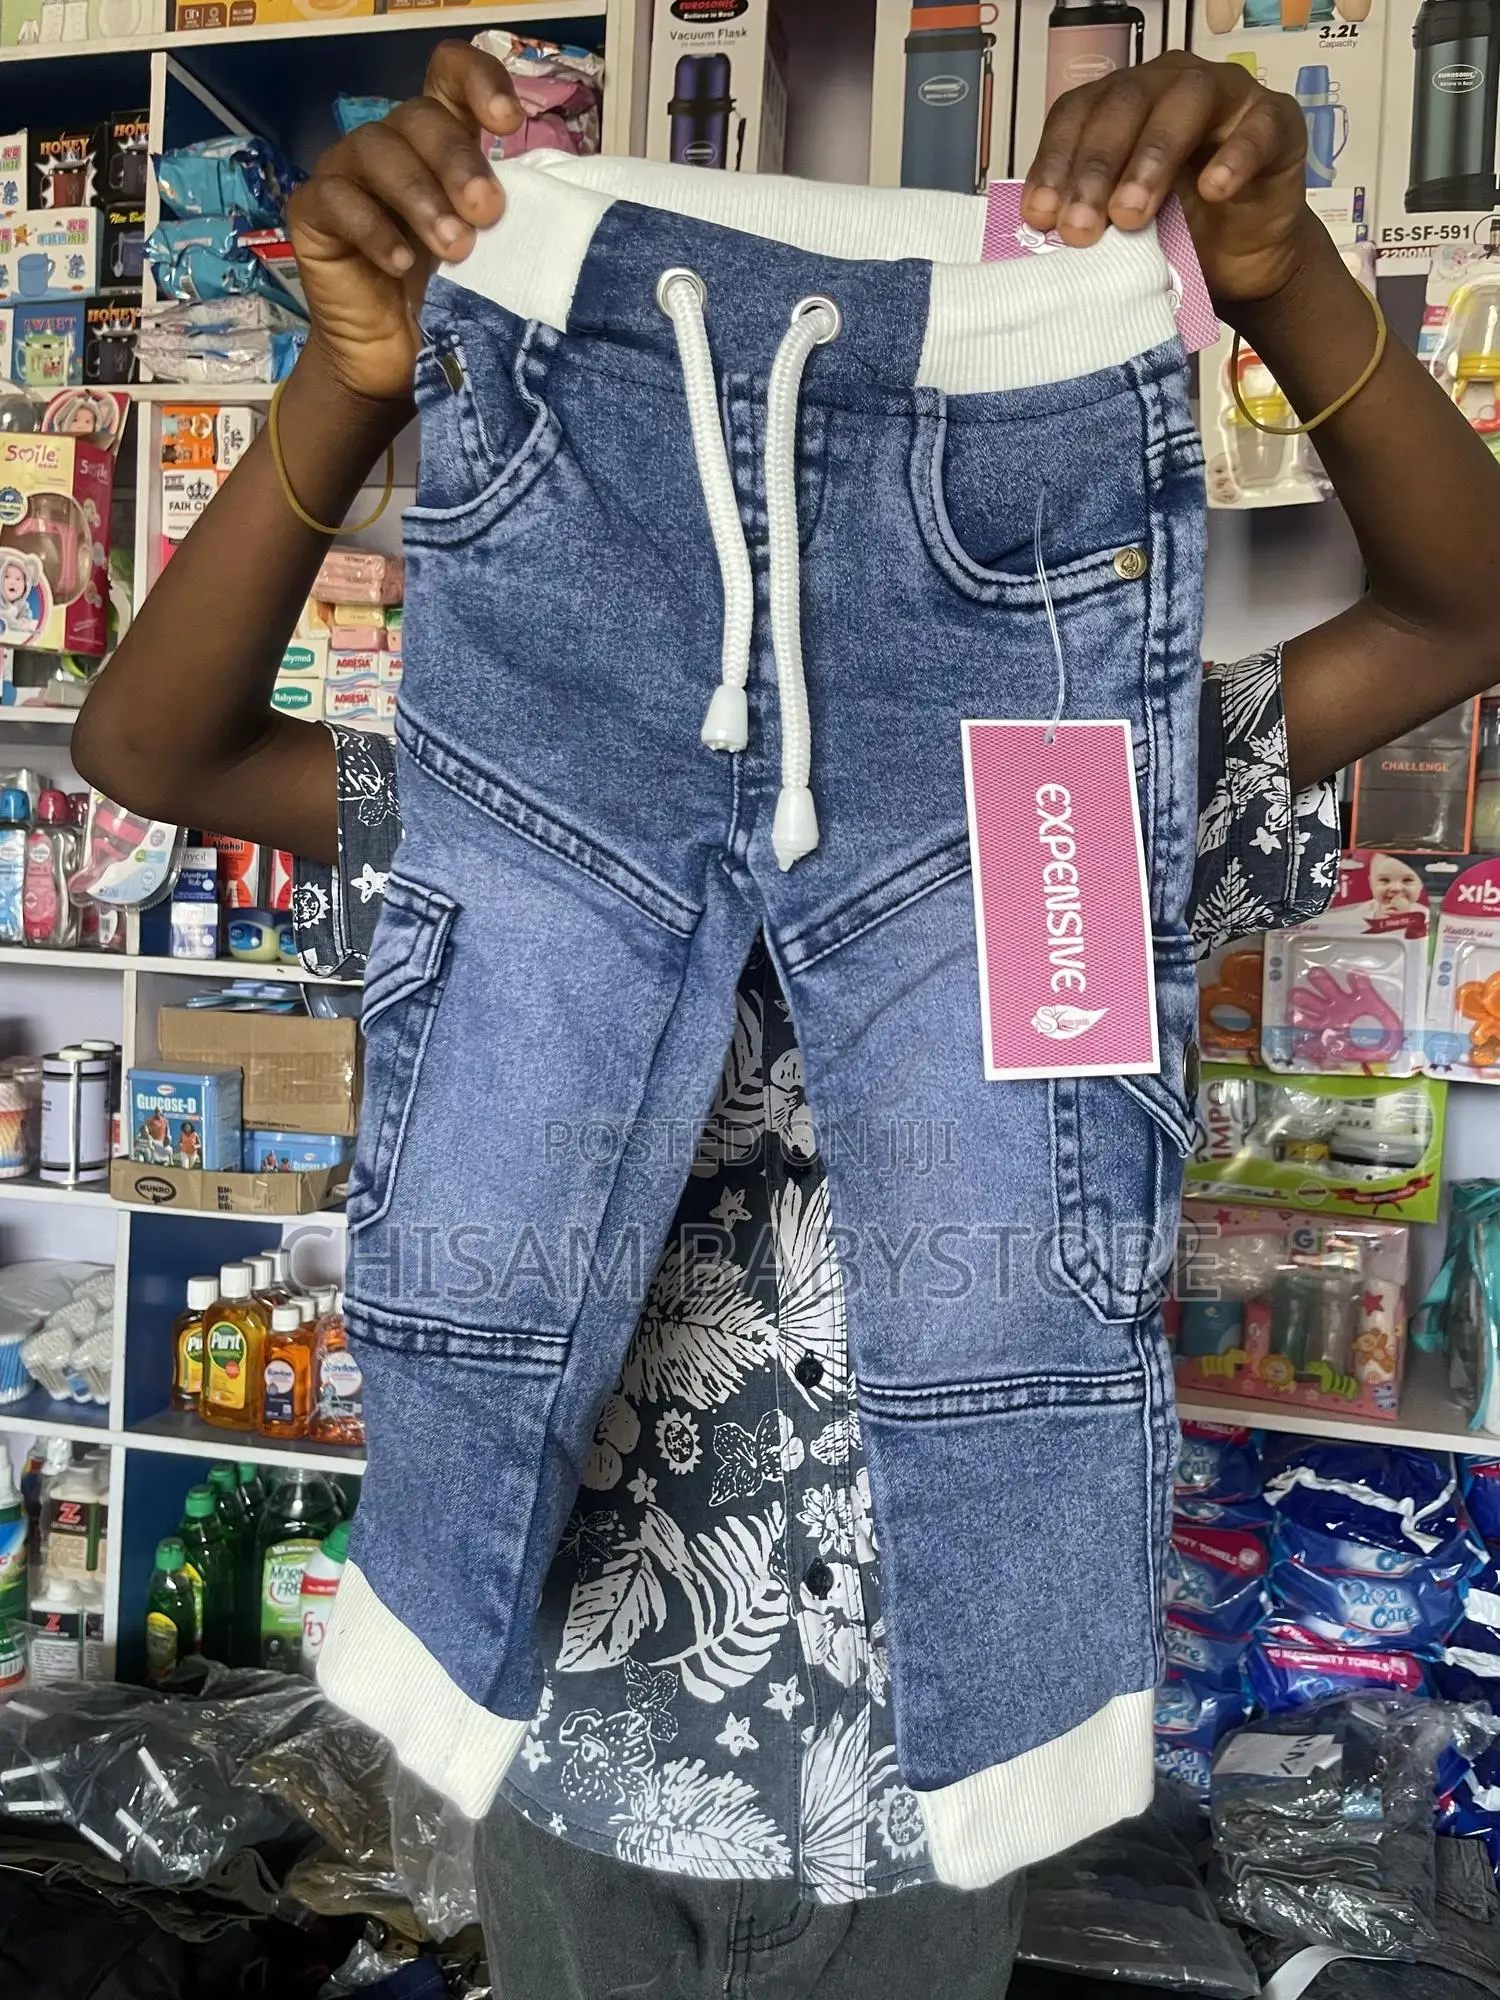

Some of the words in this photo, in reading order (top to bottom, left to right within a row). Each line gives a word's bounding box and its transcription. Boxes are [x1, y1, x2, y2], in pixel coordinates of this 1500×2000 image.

[670, 30, 714, 40] Vacuum
[718, 27, 747, 39] Flask
[1319, 24, 1359, 39] 3.2L
[1319, 40, 1358, 49] Capacity
[41, 138, 90, 158] HONEY
[1382, 225, 1470, 243] ES-SF-591
[1380, 247, 1431, 259] 2200M
[284, 654, 312, 664] abymed
[274, 693, 309, 704] Babymed
[1382, 760, 1450, 773] CHALLENGE
[136, 1093, 197, 1114] GLUCOSE-D
[188, 1336, 203, 1351] Pu
[1372, 1606, 1418, 1629] Care
